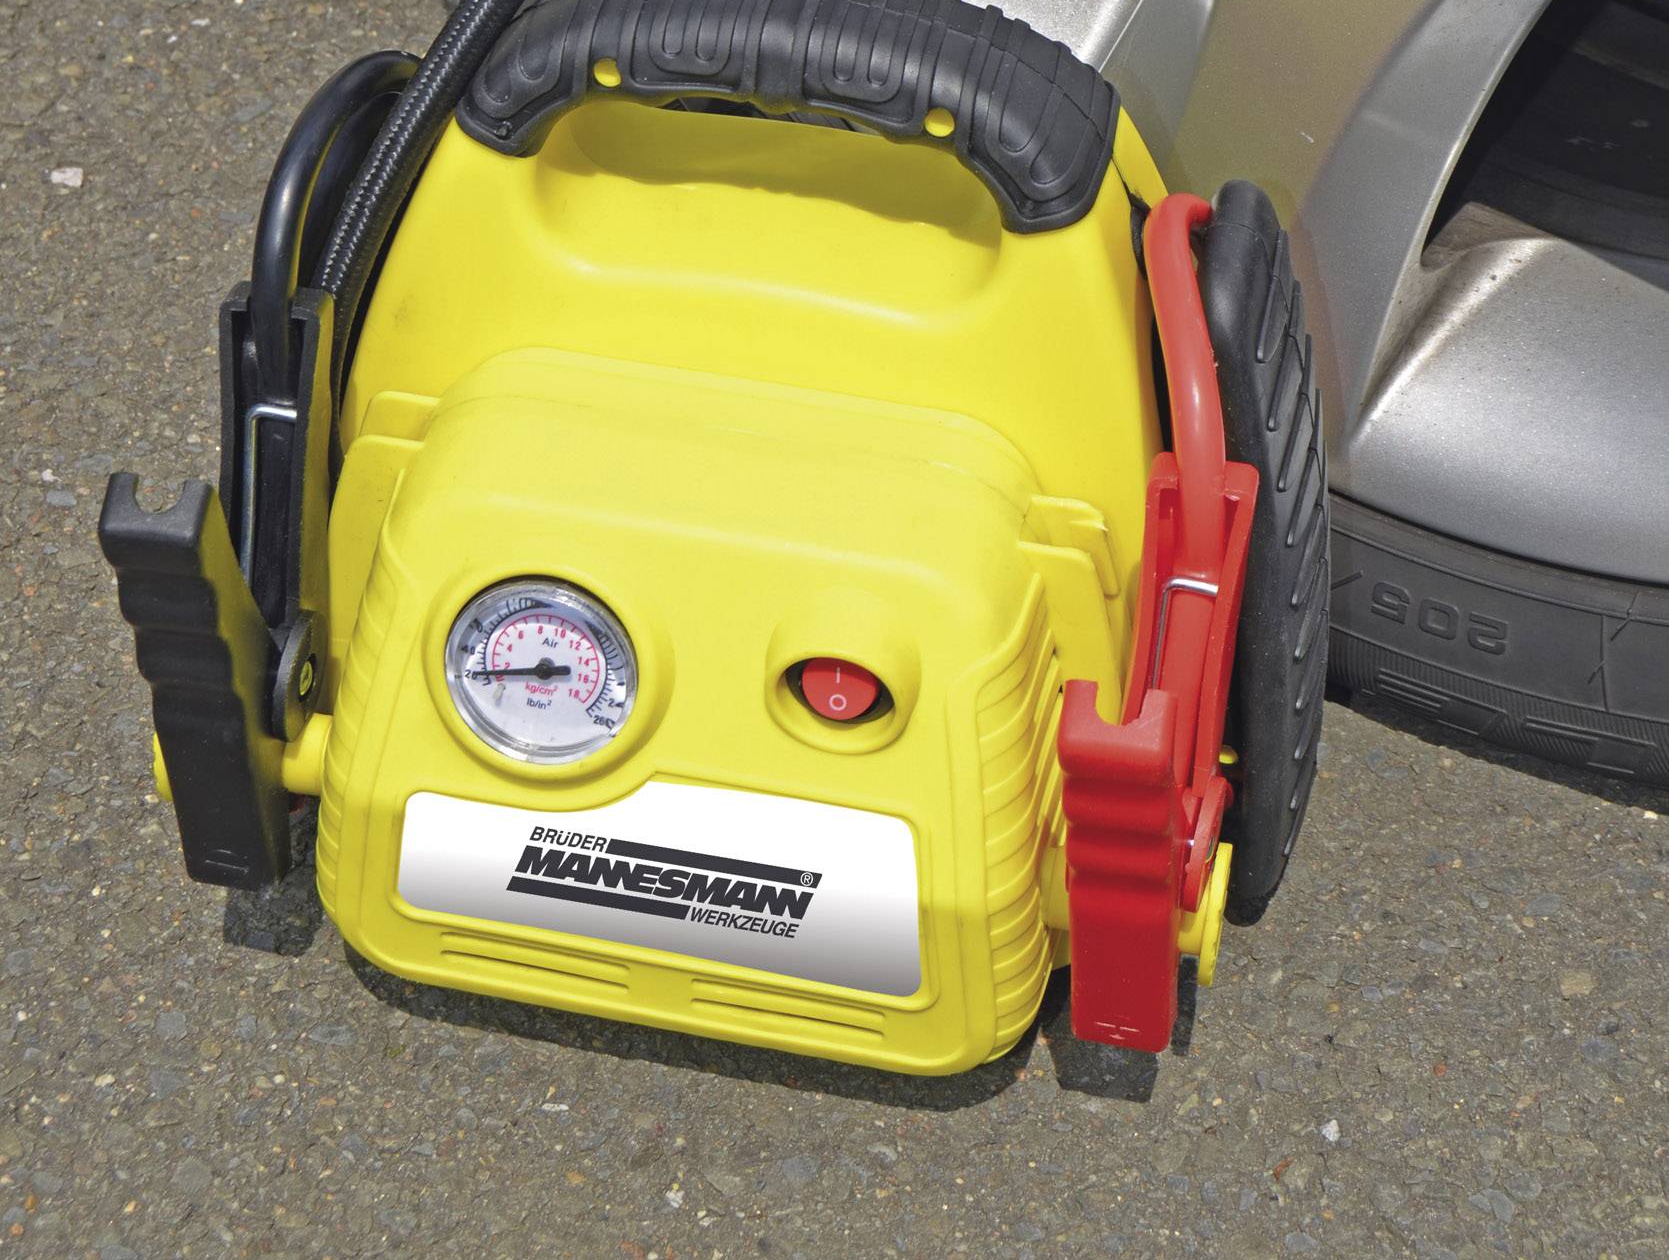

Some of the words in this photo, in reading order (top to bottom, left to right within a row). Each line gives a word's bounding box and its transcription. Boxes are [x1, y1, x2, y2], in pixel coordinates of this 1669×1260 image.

[1370, 581, 1509, 655] 205
[541, 639, 558, 648] Air
[569, 640, 581, 651] 12
[578, 657, 590, 667] 14
[578, 673, 589, 683] 16
[530, 826, 608, 853] BRÜDER
[515, 845, 813, 920] MANNESMANN
[689, 907, 800, 939] WERKZEUGE
